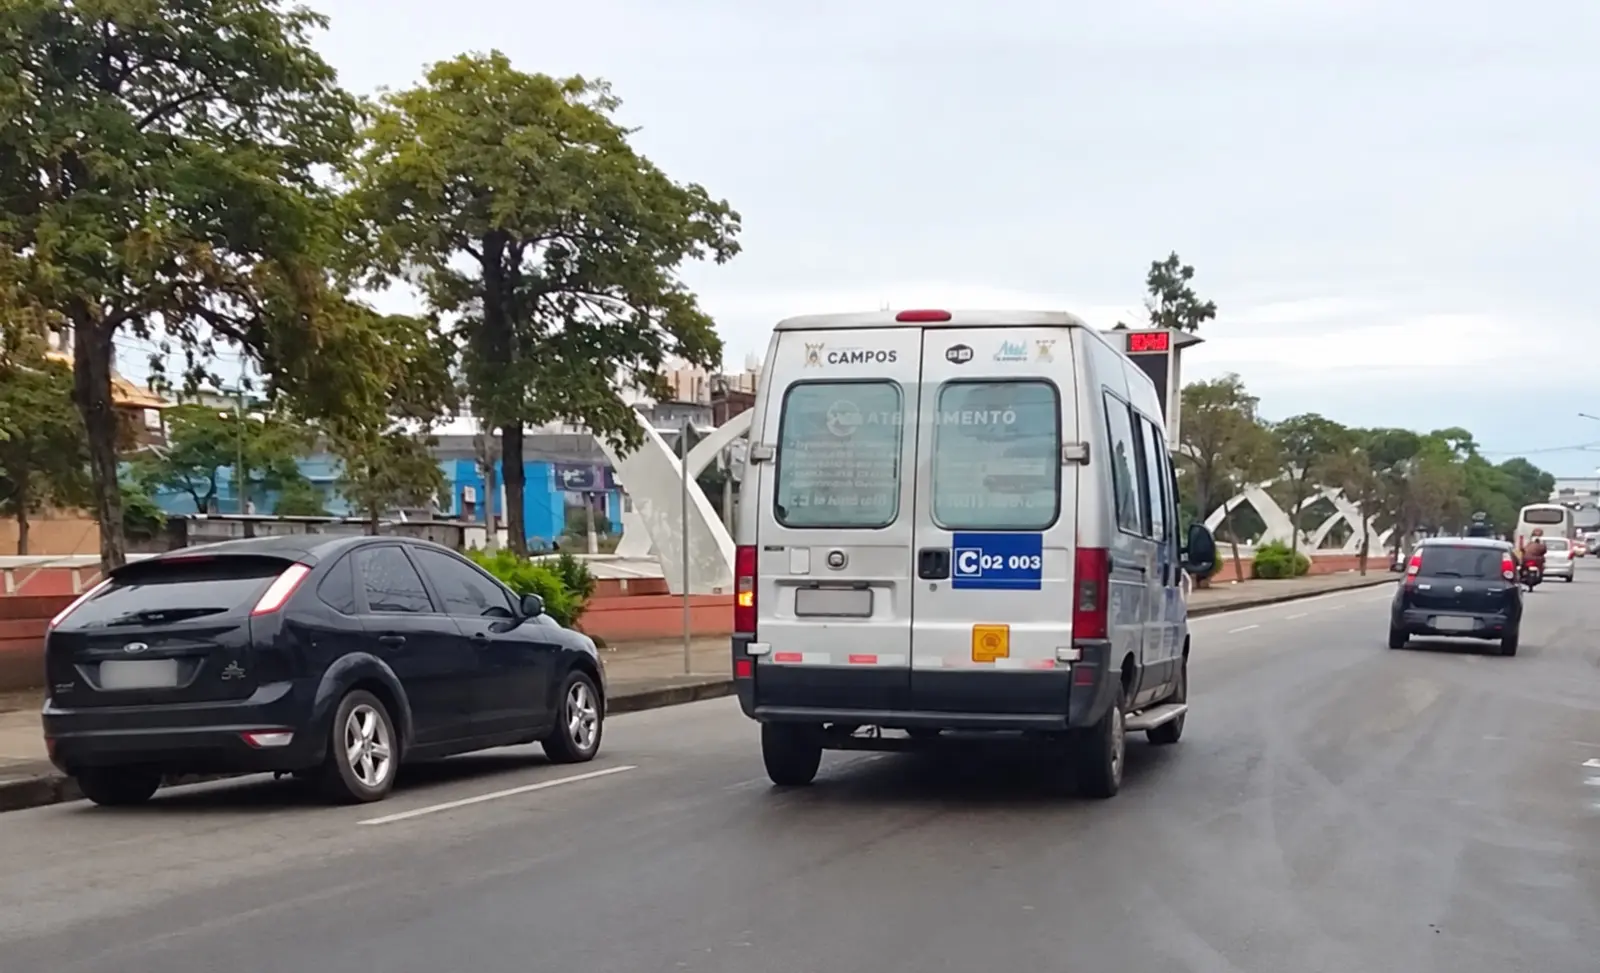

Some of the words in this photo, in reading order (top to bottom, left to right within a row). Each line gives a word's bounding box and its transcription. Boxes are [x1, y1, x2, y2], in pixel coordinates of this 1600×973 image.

[827, 350, 897, 364] CAMPOS
[867, 410, 1017, 425] ATEIMENTO
[958, 551, 978, 573] C
[981, 555, 1003, 569] 02
[1008, 555, 1041, 569] 003
